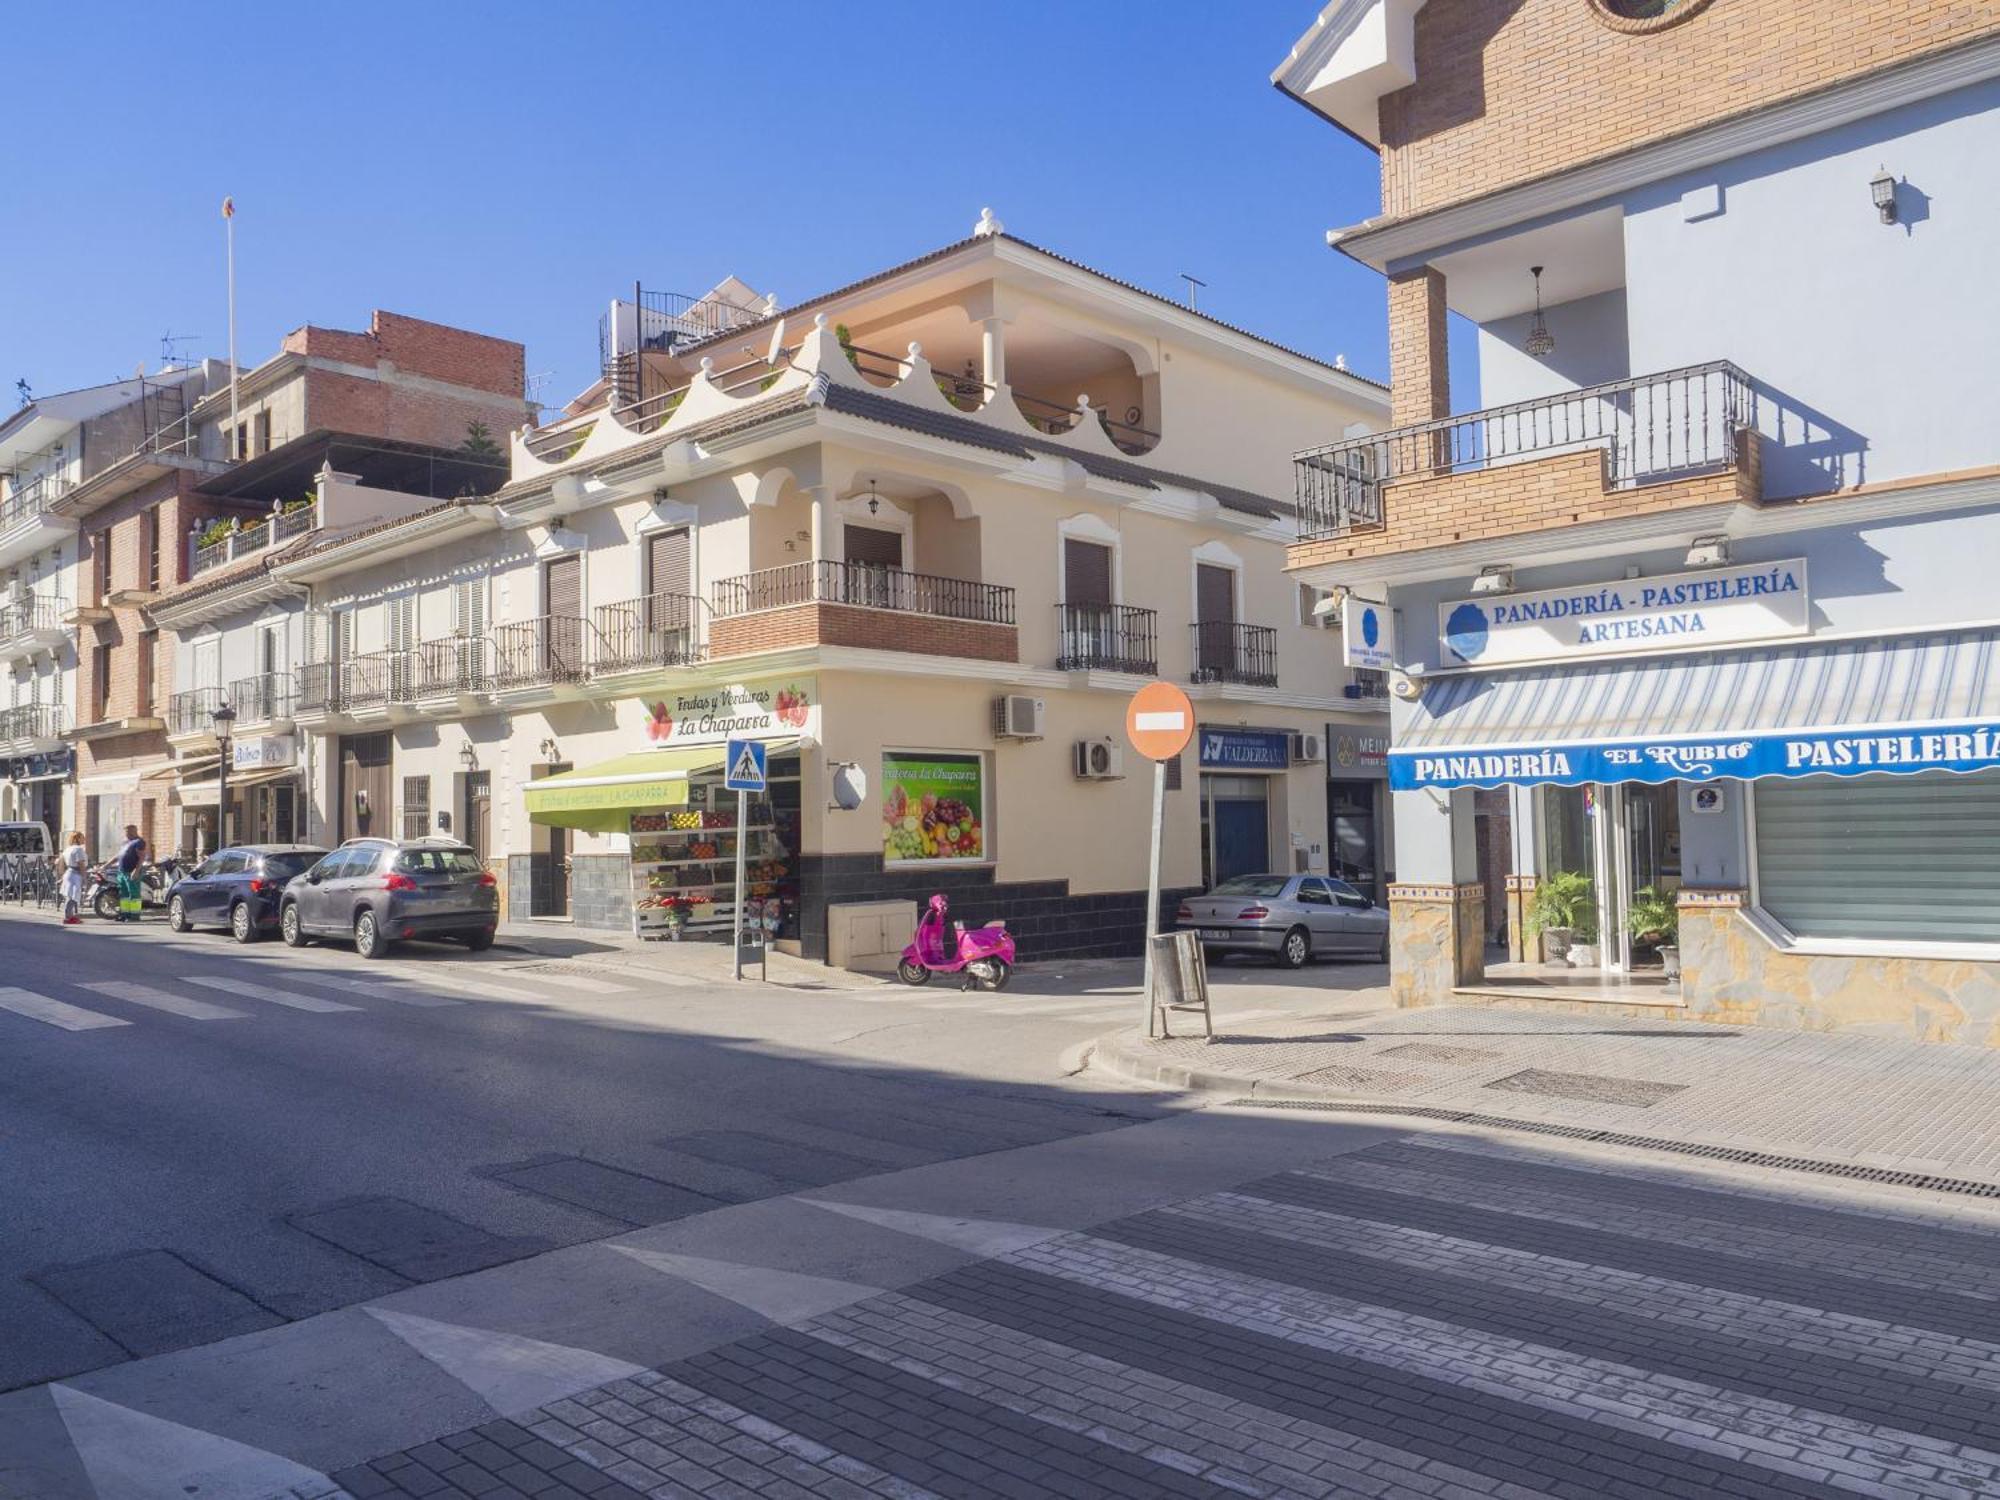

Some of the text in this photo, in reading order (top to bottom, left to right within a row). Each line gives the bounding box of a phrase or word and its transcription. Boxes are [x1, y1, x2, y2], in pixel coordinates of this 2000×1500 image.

[1493, 590, 1622, 624] PANADERÍA
[1642, 568, 1799, 608] PASTELERÍA
[1578, 612, 1705, 643] ARTESANA
[677, 690, 770, 712] Frutas y Verduras
[678, 714, 769, 737] La Chaparra
[1415, 750, 1571, 781] PANADERÍA
